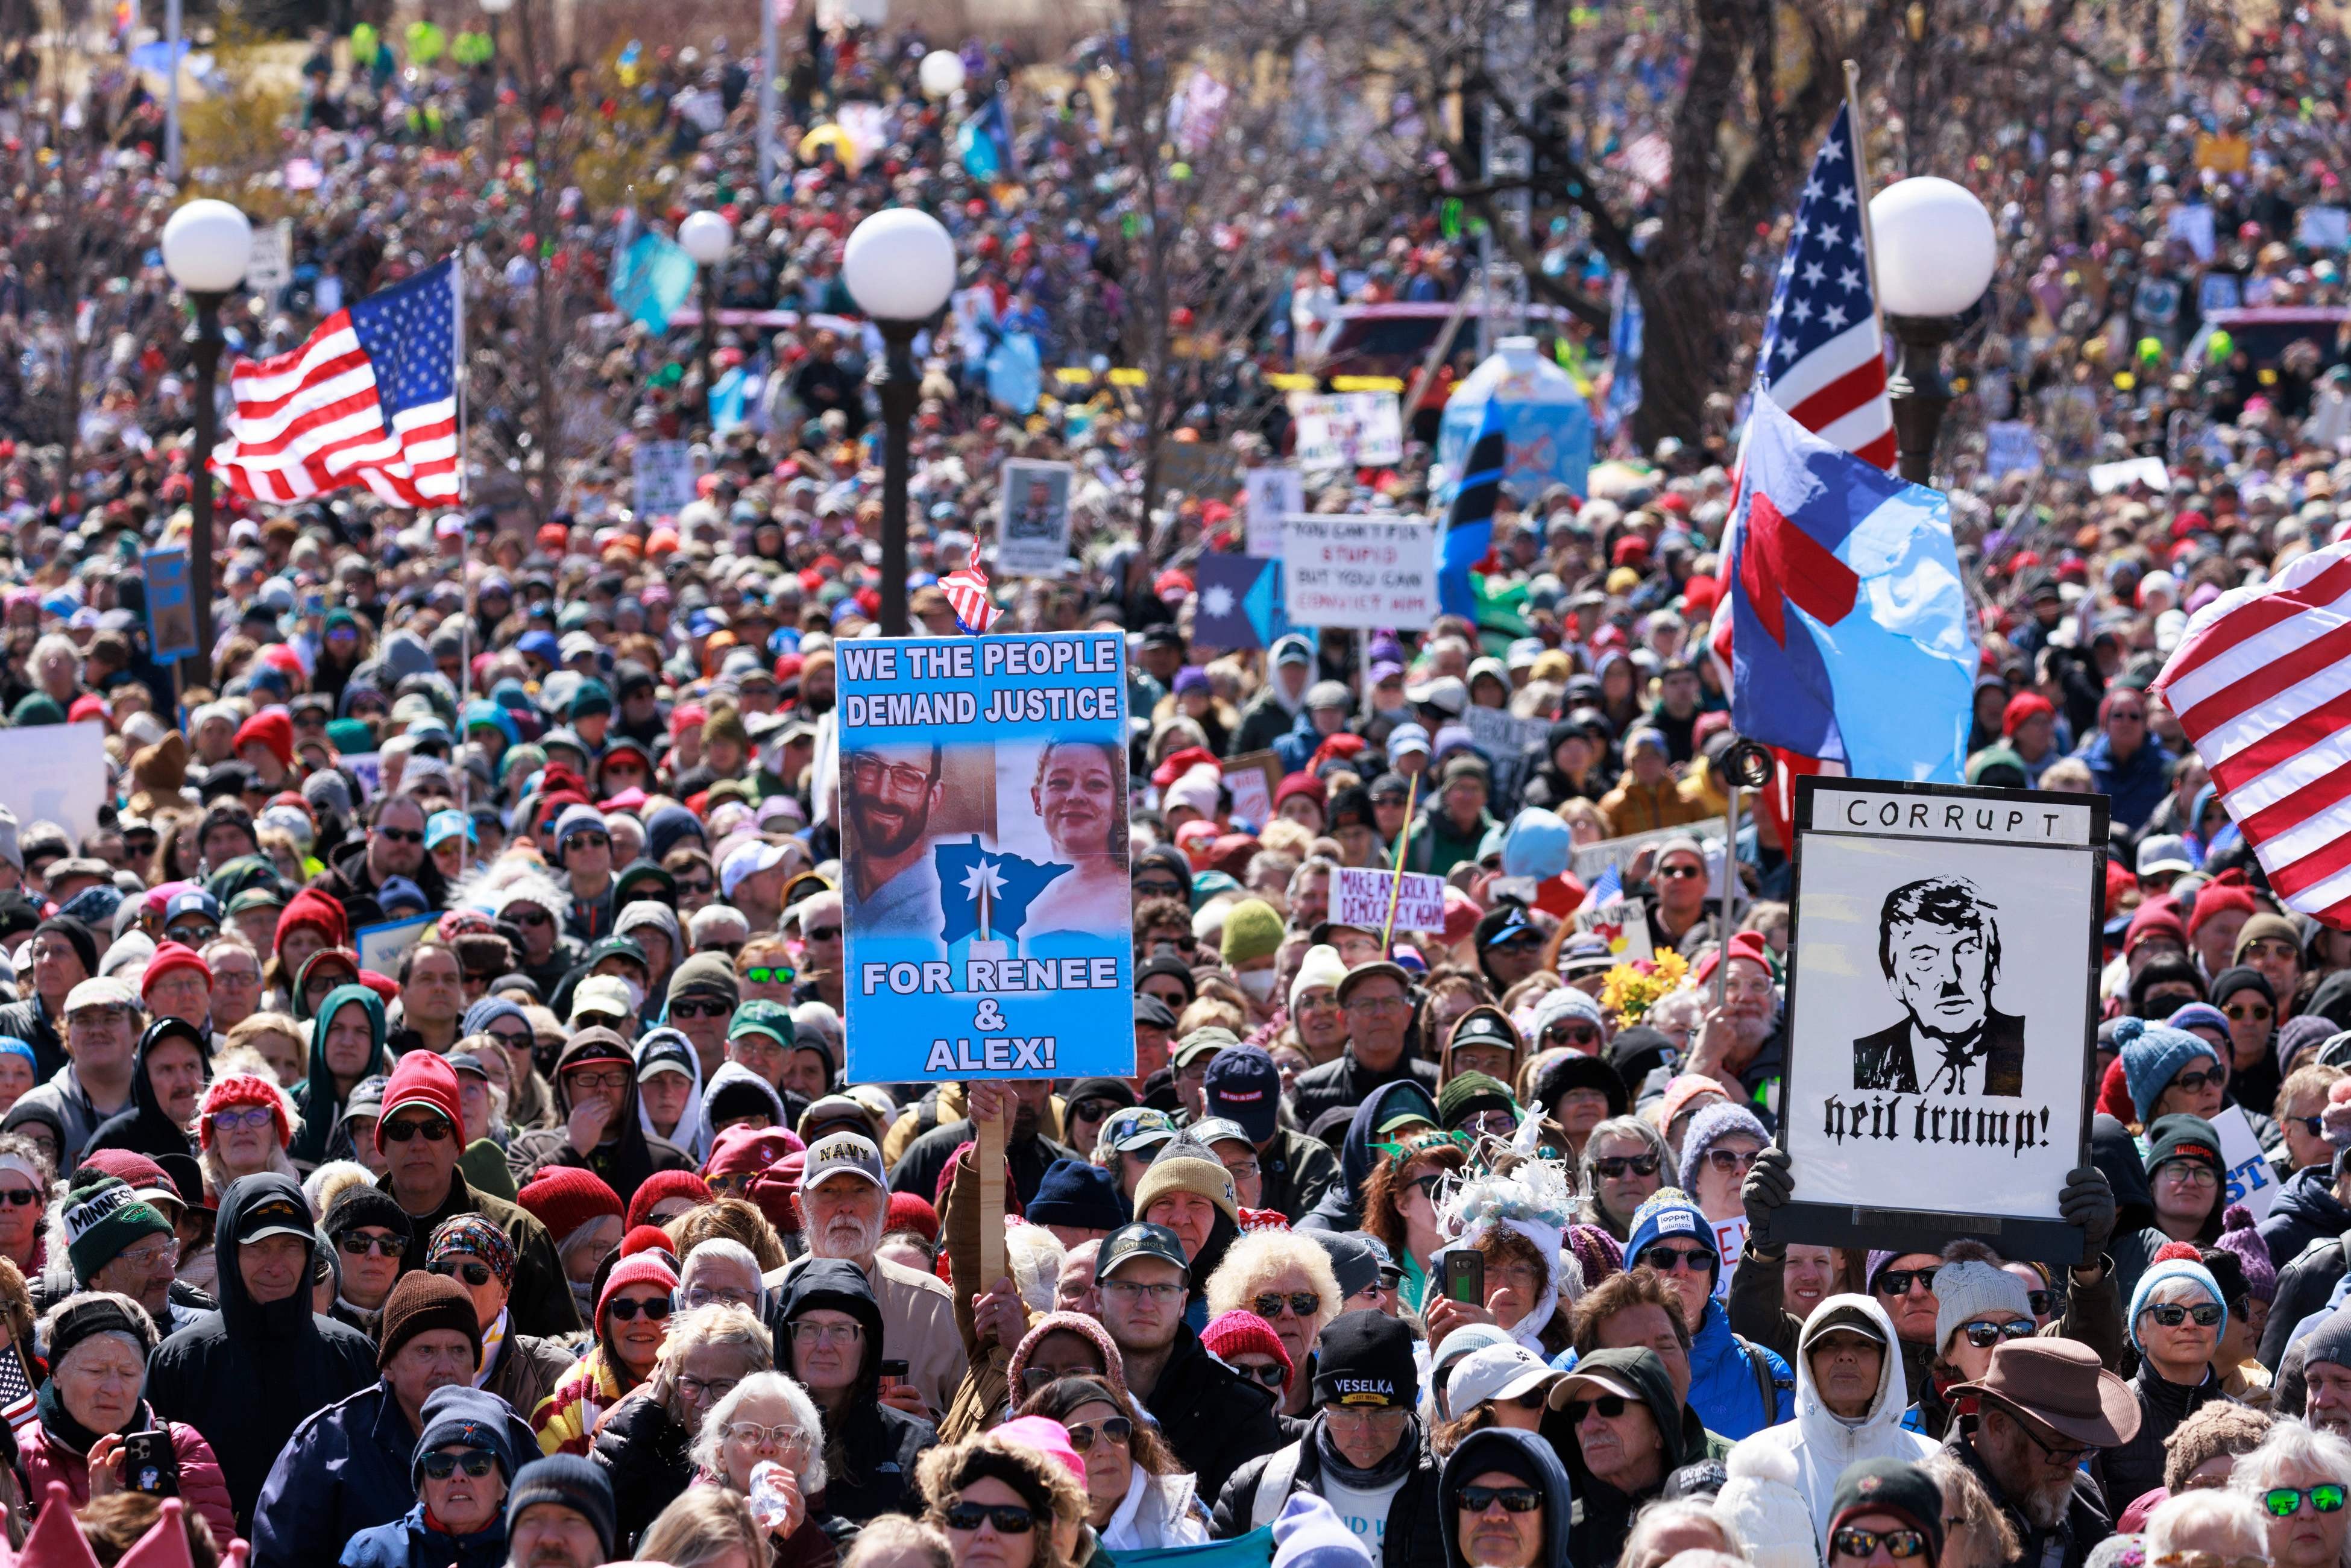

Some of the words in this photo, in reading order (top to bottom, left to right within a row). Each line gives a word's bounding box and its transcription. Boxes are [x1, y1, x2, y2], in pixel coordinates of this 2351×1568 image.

[1295, 523, 1327, 538] YOU
[1387, 524, 1418, 540] FIX
[1321, 546, 1397, 565] STUPID
[1298, 568, 1327, 587] BUT
[1337, 569, 1376, 587] YOU
[1382, 570, 1422, 588] CAN
[1298, 593, 1382, 610] CONVICT
[844, 647, 897, 680] WE
[904, 645, 974, 679] THE
[983, 639, 1117, 676] PEOPLE
[846, 691, 977, 726] DEMAND
[983, 687, 1118, 723] JUSTICE
[1847, 799, 2059, 837] CORRUPT
[1341, 869, 1374, 897] MAKE
[1435, 878, 1444, 902] A
[862, 961, 954, 995] FOR
[966, 957, 1118, 993] RENEE
[973, 998, 1007, 1032] &
[924, 1036, 1056, 1072] ALEX!
[1913, 1098, 2050, 1159] trump!
[820, 1142, 870, 1162] NAVY
[1661, 1214, 1690, 1224] loppet
[1662, 1222, 1691, 1230] volunteer
[1113, 1241, 1166, 1256] MARTINIQUE
[1335, 1379, 1394, 1395] VESELKA
[1680, 1478, 1695, 1489] HAVE
